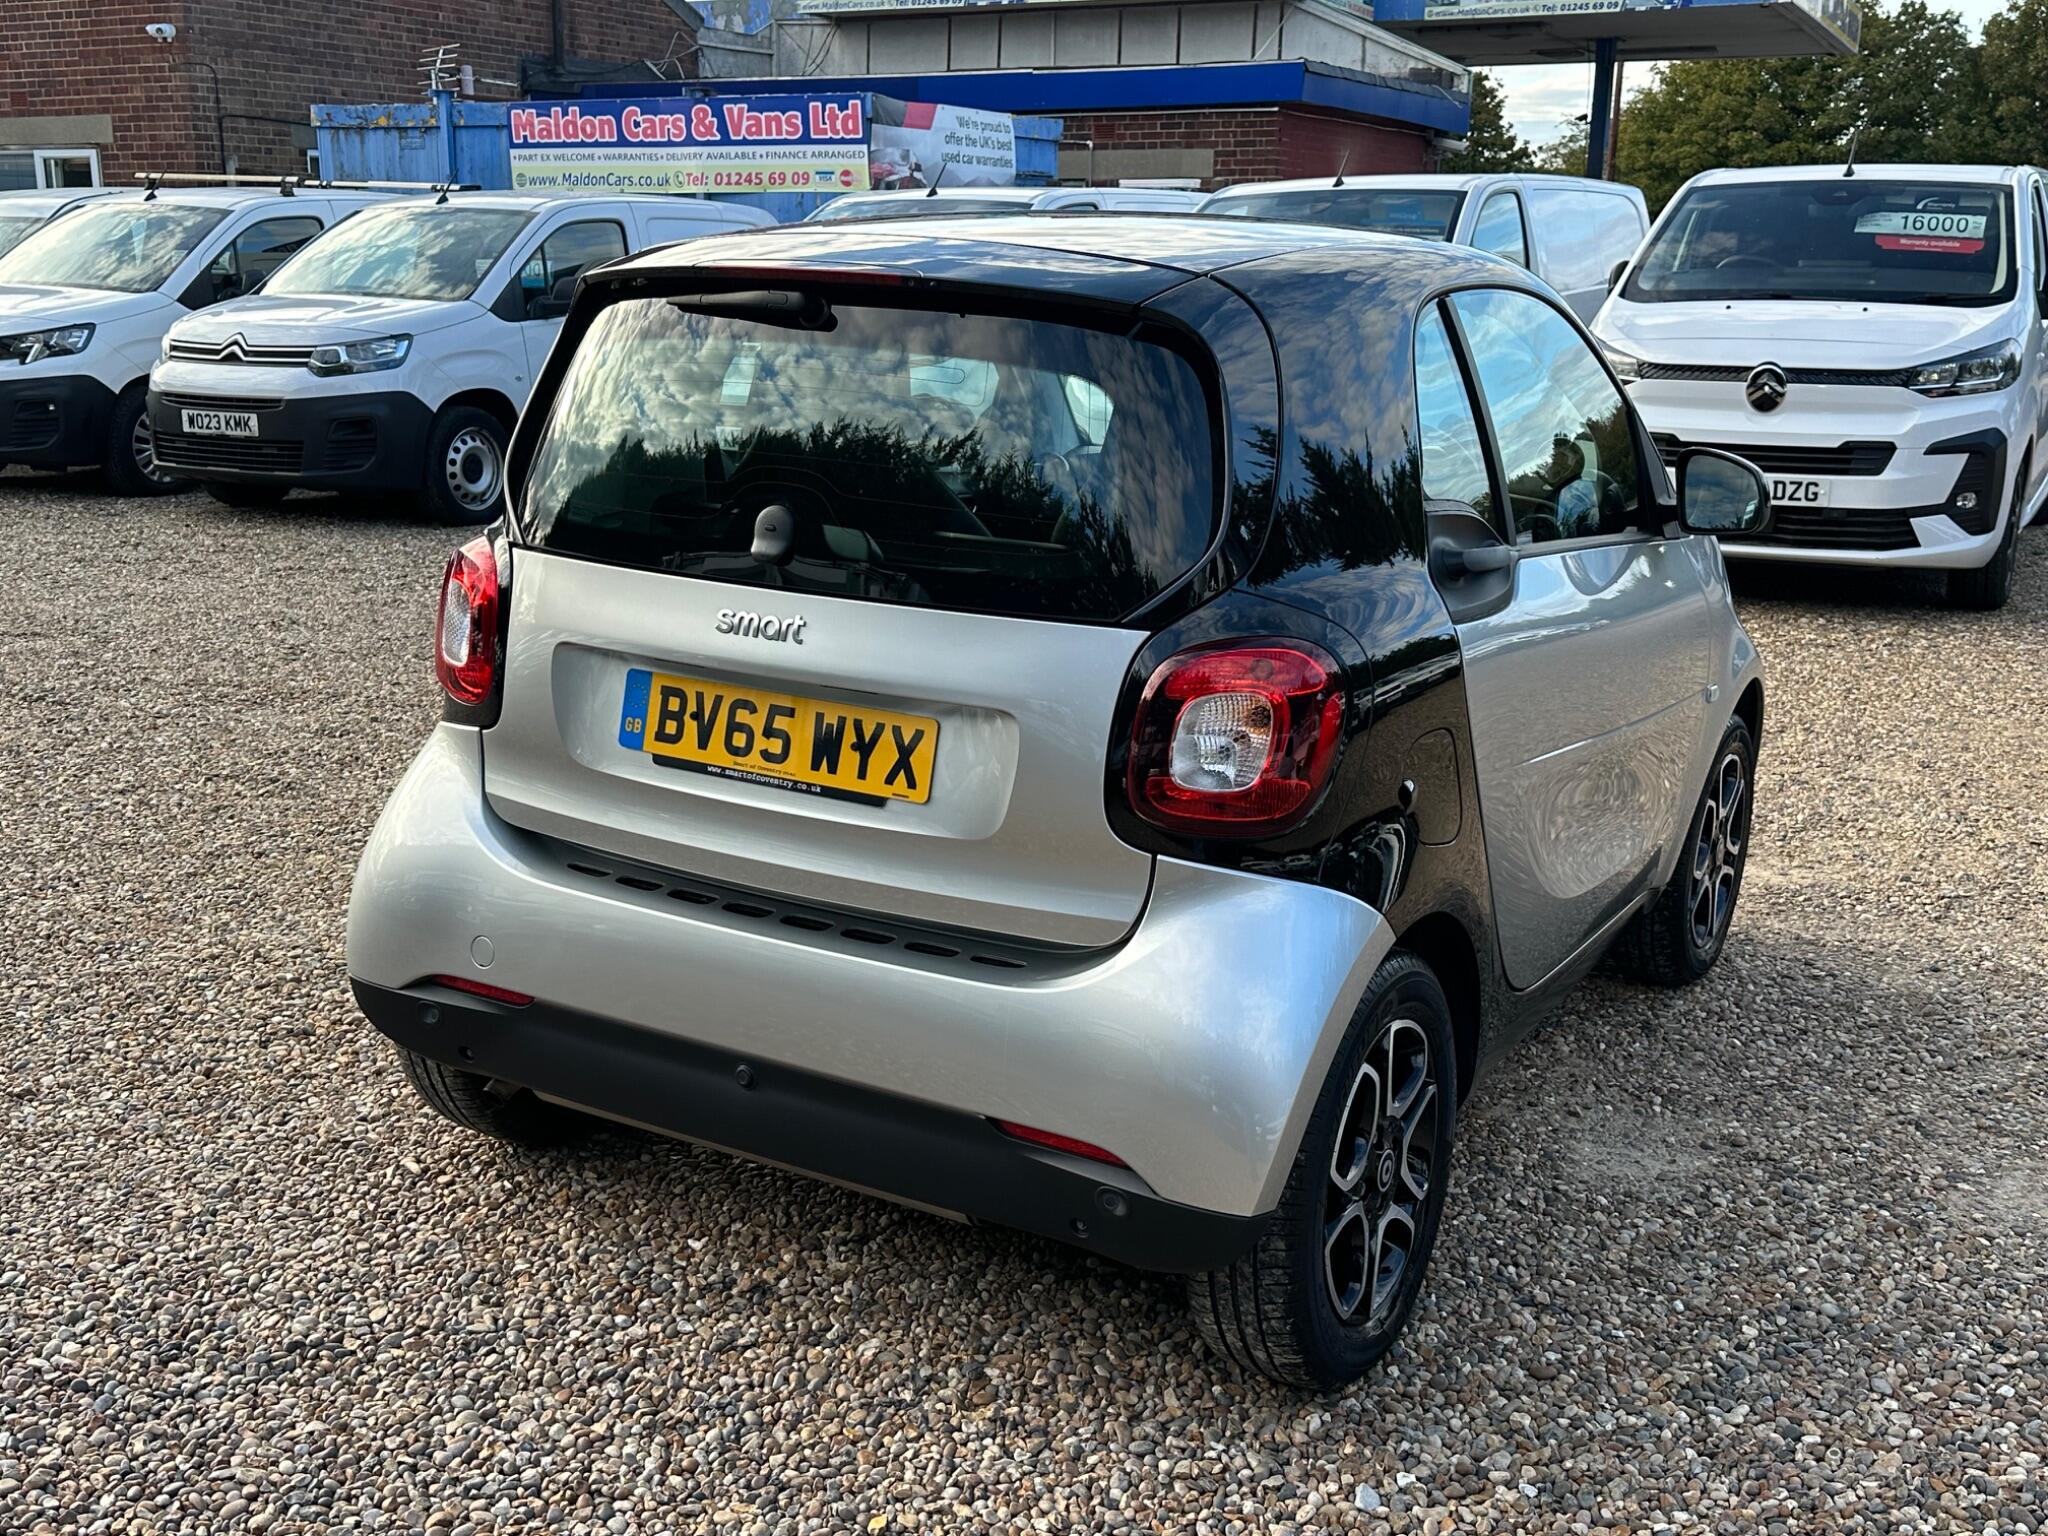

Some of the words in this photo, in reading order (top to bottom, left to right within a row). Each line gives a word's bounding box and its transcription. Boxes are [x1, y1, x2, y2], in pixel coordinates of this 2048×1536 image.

[1560, 2, 1590, 12] 01245
[1592, 1, 1605, 10] 69
[1606, 1, 1619, 10] 09
[511, 107, 617, 143] Maldon
[622, 105, 686, 142] Cars
[691, 104, 721, 140] &
[723, 103, 802, 140] Vans
[809, 100, 863, 139] Ltd
[980, 121, 1002, 134] proud
[1003, 122, 1011, 134] to
[945, 131, 964, 146] offer
[965, 134, 978, 148] the
[997, 137, 1013, 151] best
[518, 154, 538, 162] PART
[553, 153, 595, 161] WELCOME
[604, 153, 659, 161] WARRANTIES
[666, 152, 703, 161] DELIVERY
[706, 151, 757, 160] AVAILABLE
[766, 151, 808, 160] FINANCE
[811, 150, 865, 160] ARRANGED
[941, 151, 960, 164] used
[962, 154, 974, 165] car
[528, 172, 671, 187] www.MaldonCars.co.uk
[685, 172, 709, 186] Tel:
[714, 171, 763, 186] 01245
[768, 171, 786, 186] 69
[791, 171, 810, 186] 09
[1901, 215, 1969, 233] 16000
[187, 412, 221, 431] WO23
[224, 414, 252, 432] KMK
[1771, 480, 1819, 502] DZG
[715, 608, 807, 645] smart
[625, 716, 642, 733] GB
[654, 684, 797, 765] BV65
[810, 711, 926, 790] WYX
[707, 765, 822, 793] www.smartofcoventry.co.uk
